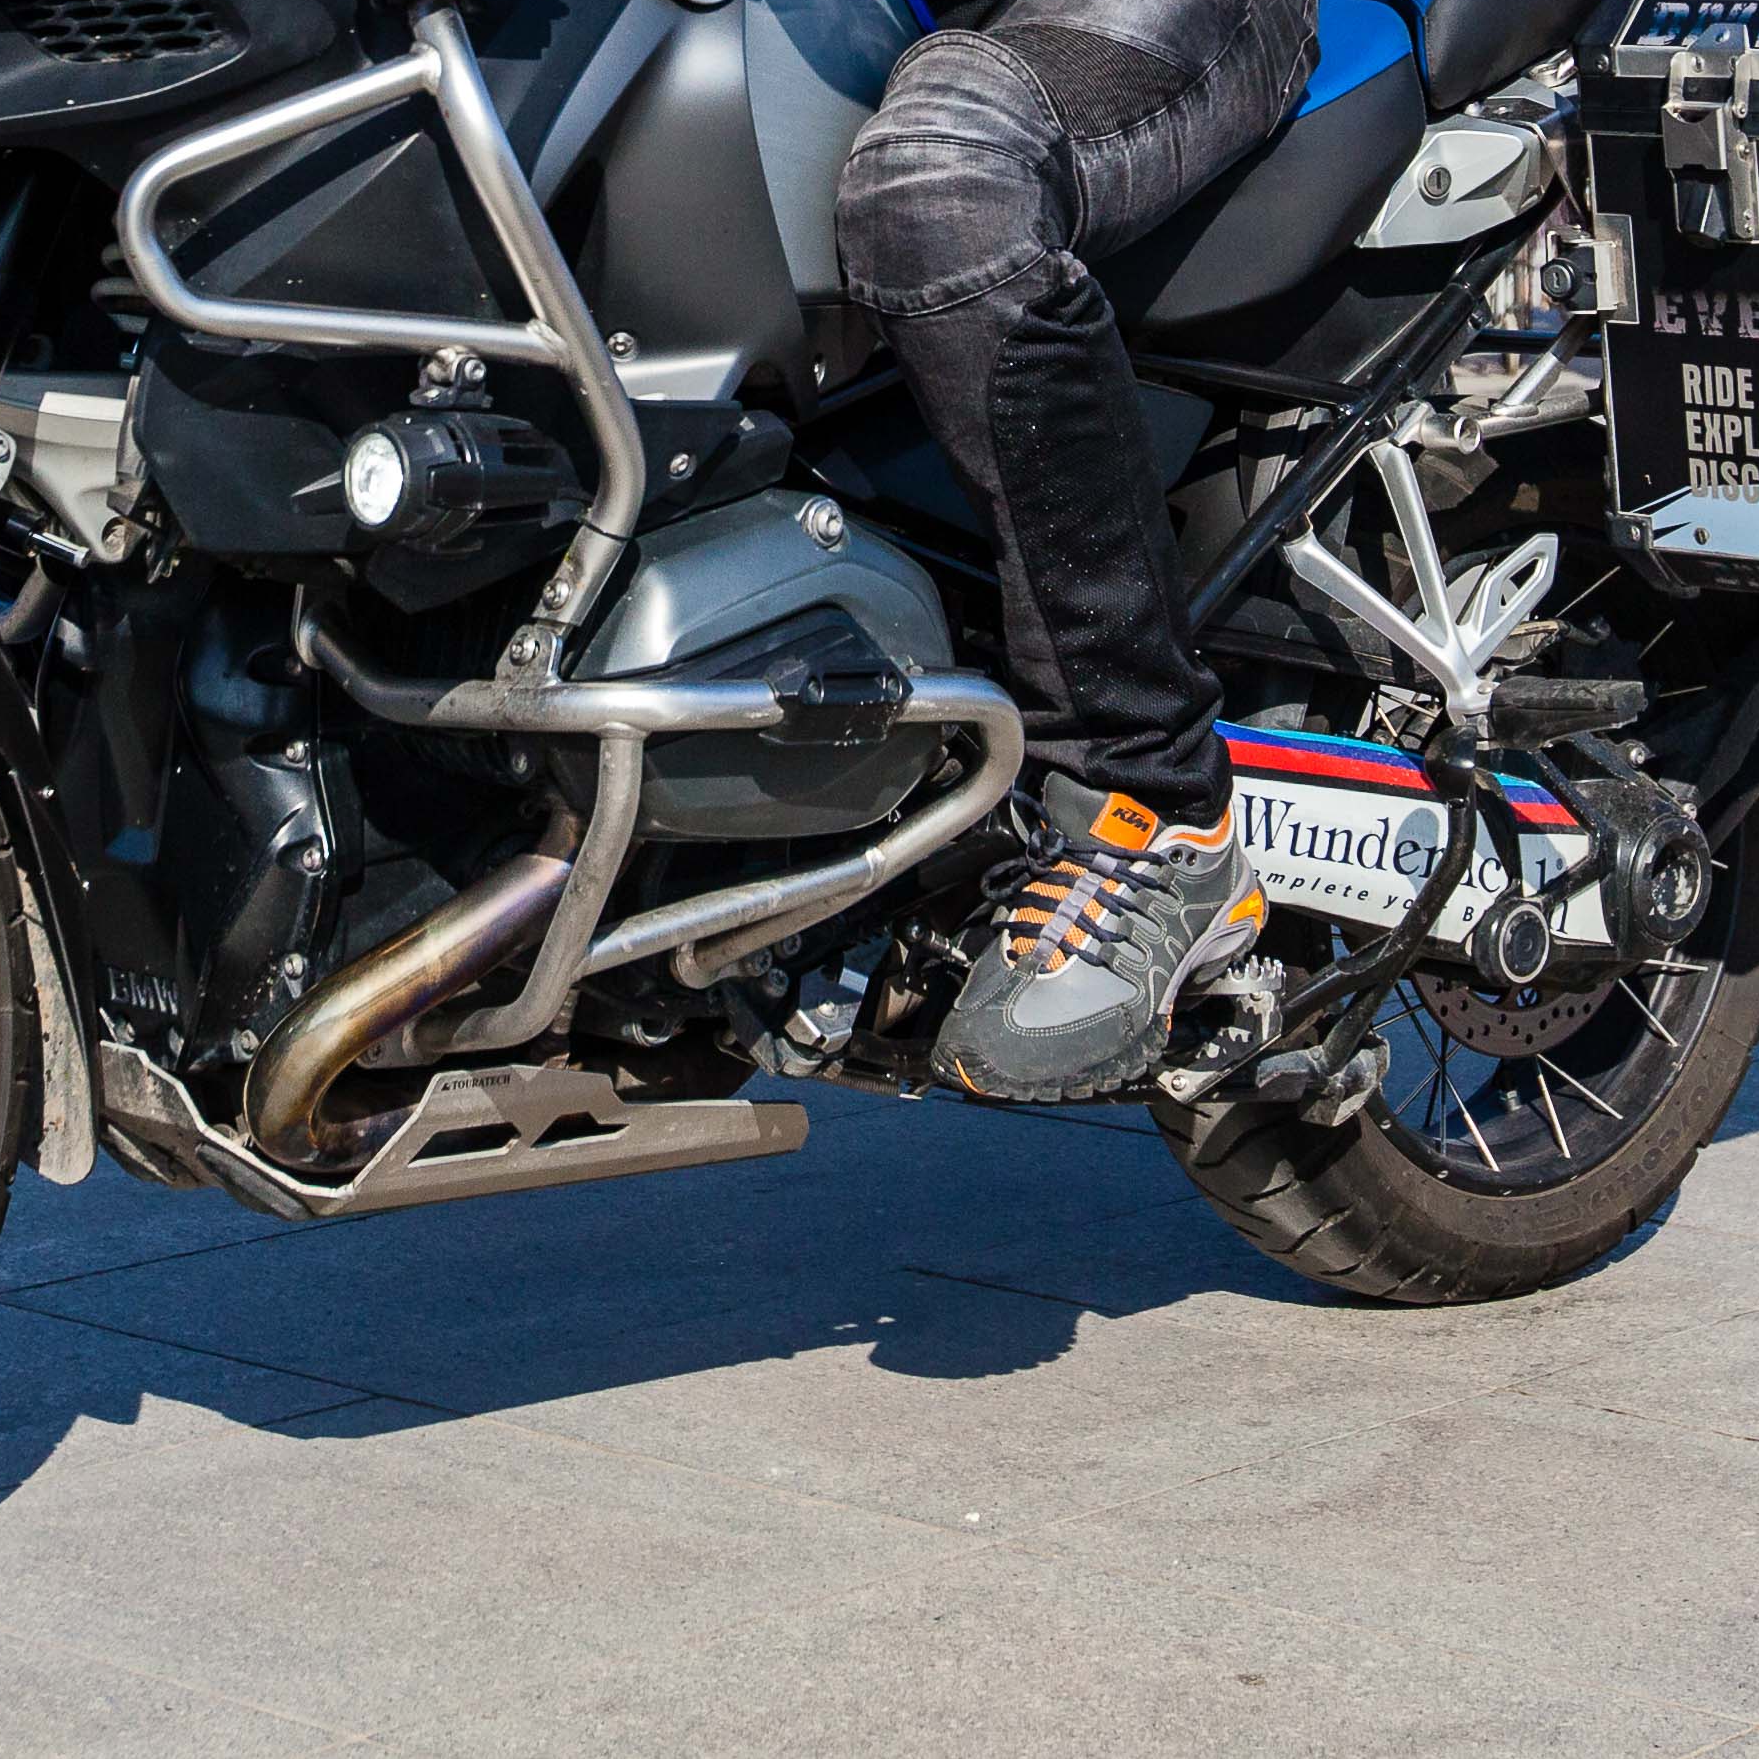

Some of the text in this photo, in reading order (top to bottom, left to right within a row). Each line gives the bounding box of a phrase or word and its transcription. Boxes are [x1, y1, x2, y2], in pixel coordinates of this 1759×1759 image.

[1682, 363, 1755, 409] RIDE
[1110, 807, 1150, 832] KTM
[108, 967, 178, 1016] BMW
[452, 1074, 511, 1090] TOURATECH
